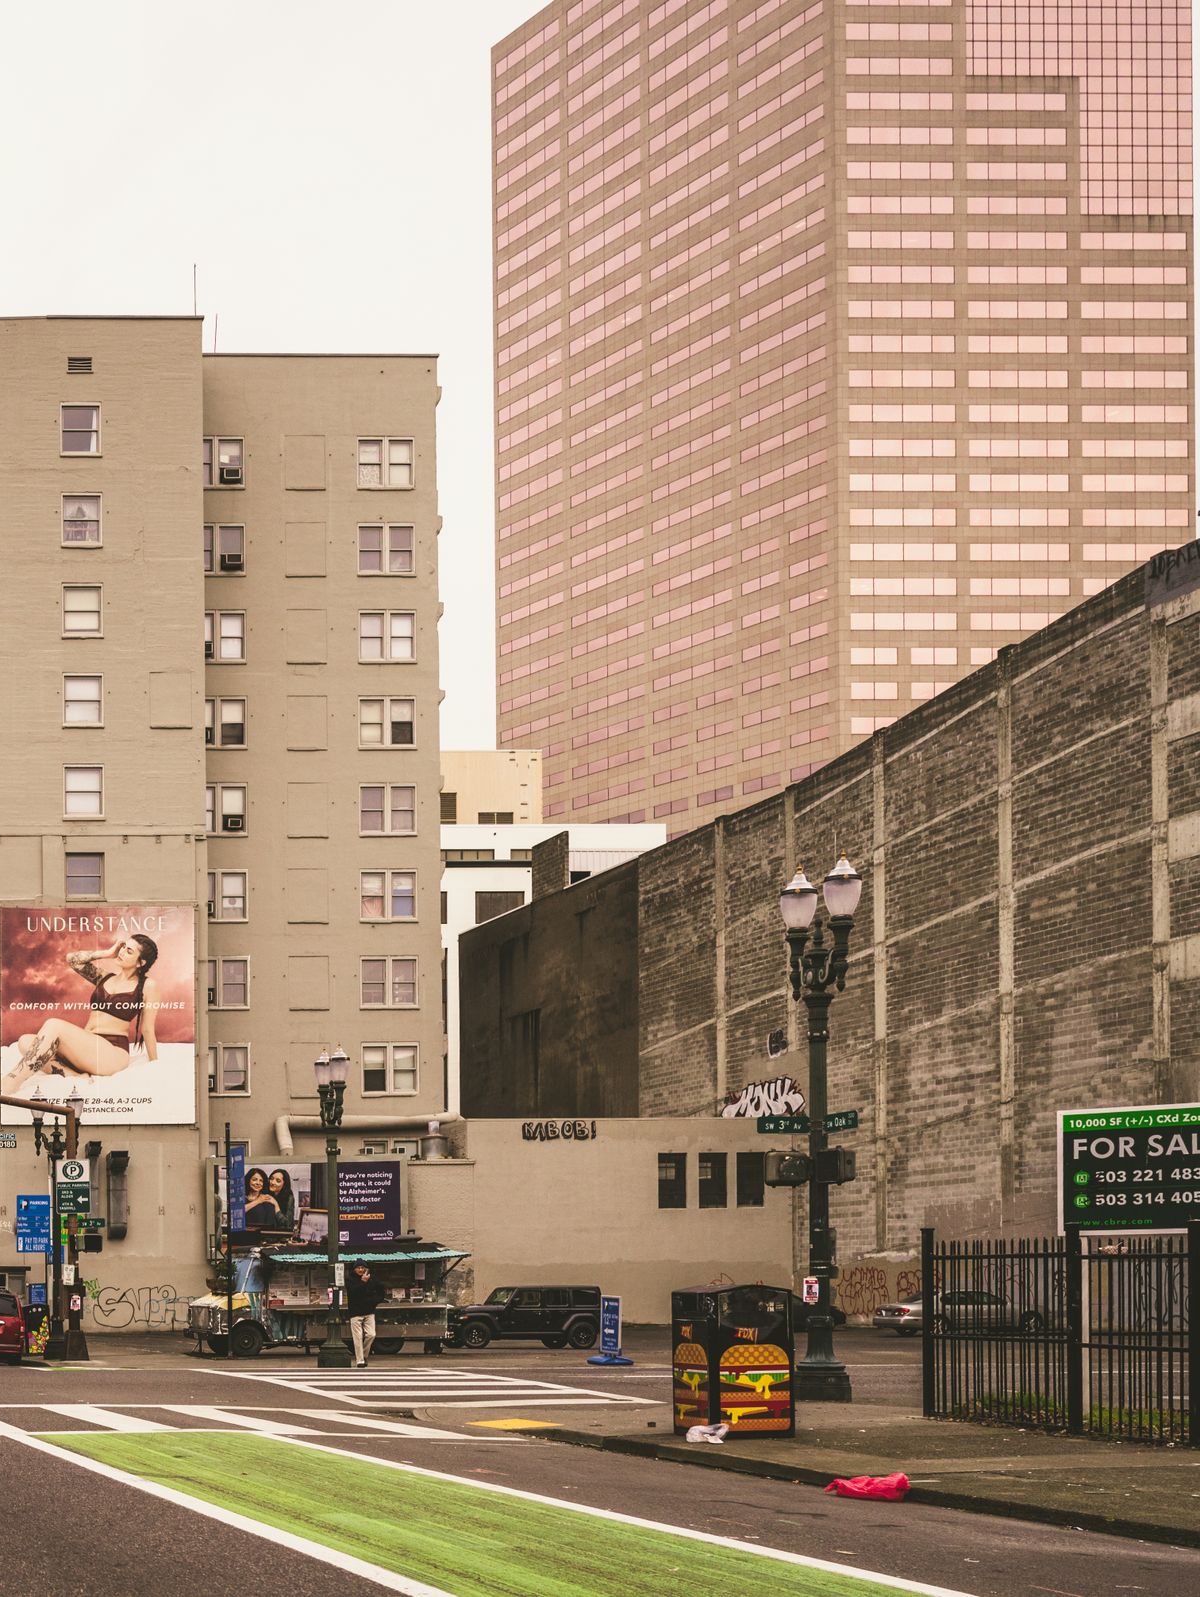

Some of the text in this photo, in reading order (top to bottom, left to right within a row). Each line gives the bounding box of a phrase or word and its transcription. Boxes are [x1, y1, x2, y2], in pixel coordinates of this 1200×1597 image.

[26, 916, 167, 932] UNDERSTANCE
[9, 1001, 186, 1011] COMFORT WITHOUT COMPROMISE
[778, 1120, 789, 1130] 3rd
[834, 1117, 846, 1127] Oak
[1069, 1113, 1200, 1129] 10,000 SF (+/-) CXd Zo
[522, 1120, 597, 1141] KABOB!
[1073, 1133, 1200, 1160] FOR SAL
[70, 1166, 77, 1175] P
[345, 1172, 366, 1180] you're
[366, 1171, 393, 1179] noticing
[1133, 1169, 1163, 1182] 221
[1171, 1167, 1200, 1180] 483
[1095, 1191, 1200, 1206] 503 314 405
[1080, 1218, 1153, 1226] ww.cbre.com
